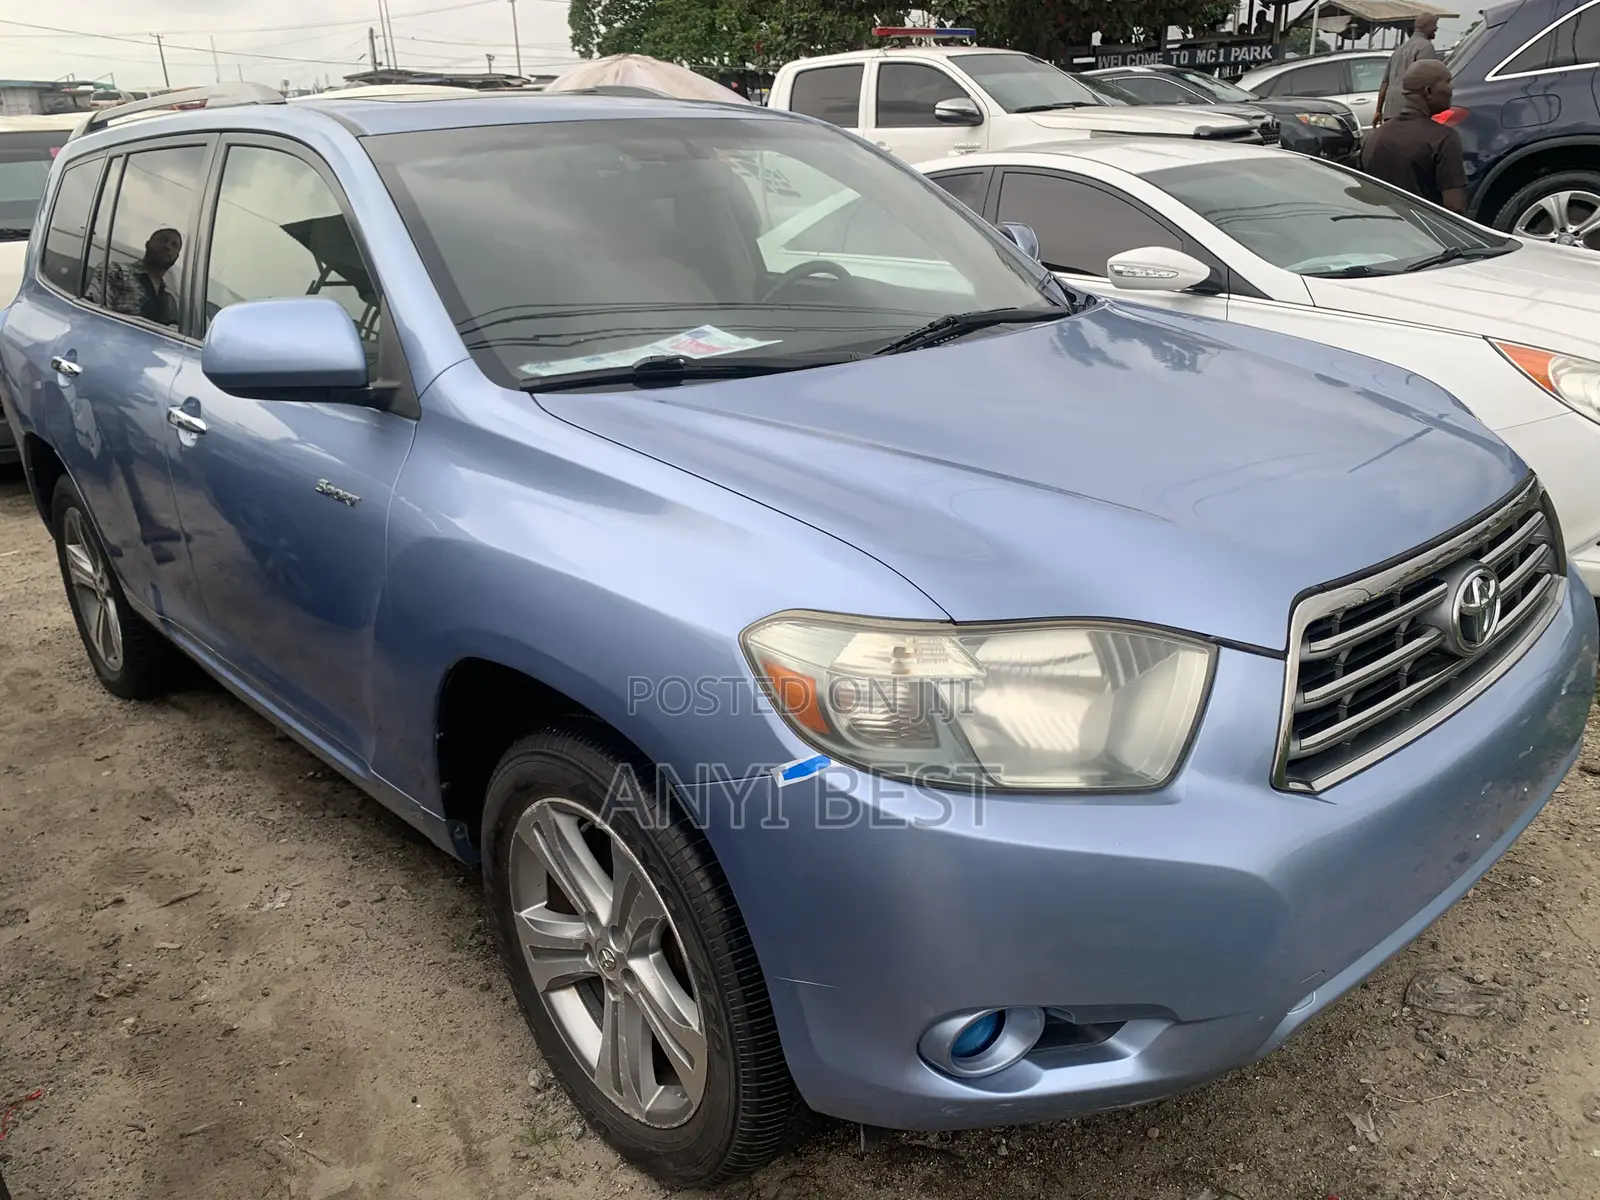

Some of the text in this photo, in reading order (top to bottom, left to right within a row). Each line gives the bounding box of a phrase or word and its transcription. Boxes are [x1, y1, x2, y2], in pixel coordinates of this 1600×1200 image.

[1098, 52, 1163, 69] WELCOME
[1171, 50, 1189, 65] TO
[1230, 45, 1273, 61] PARK
